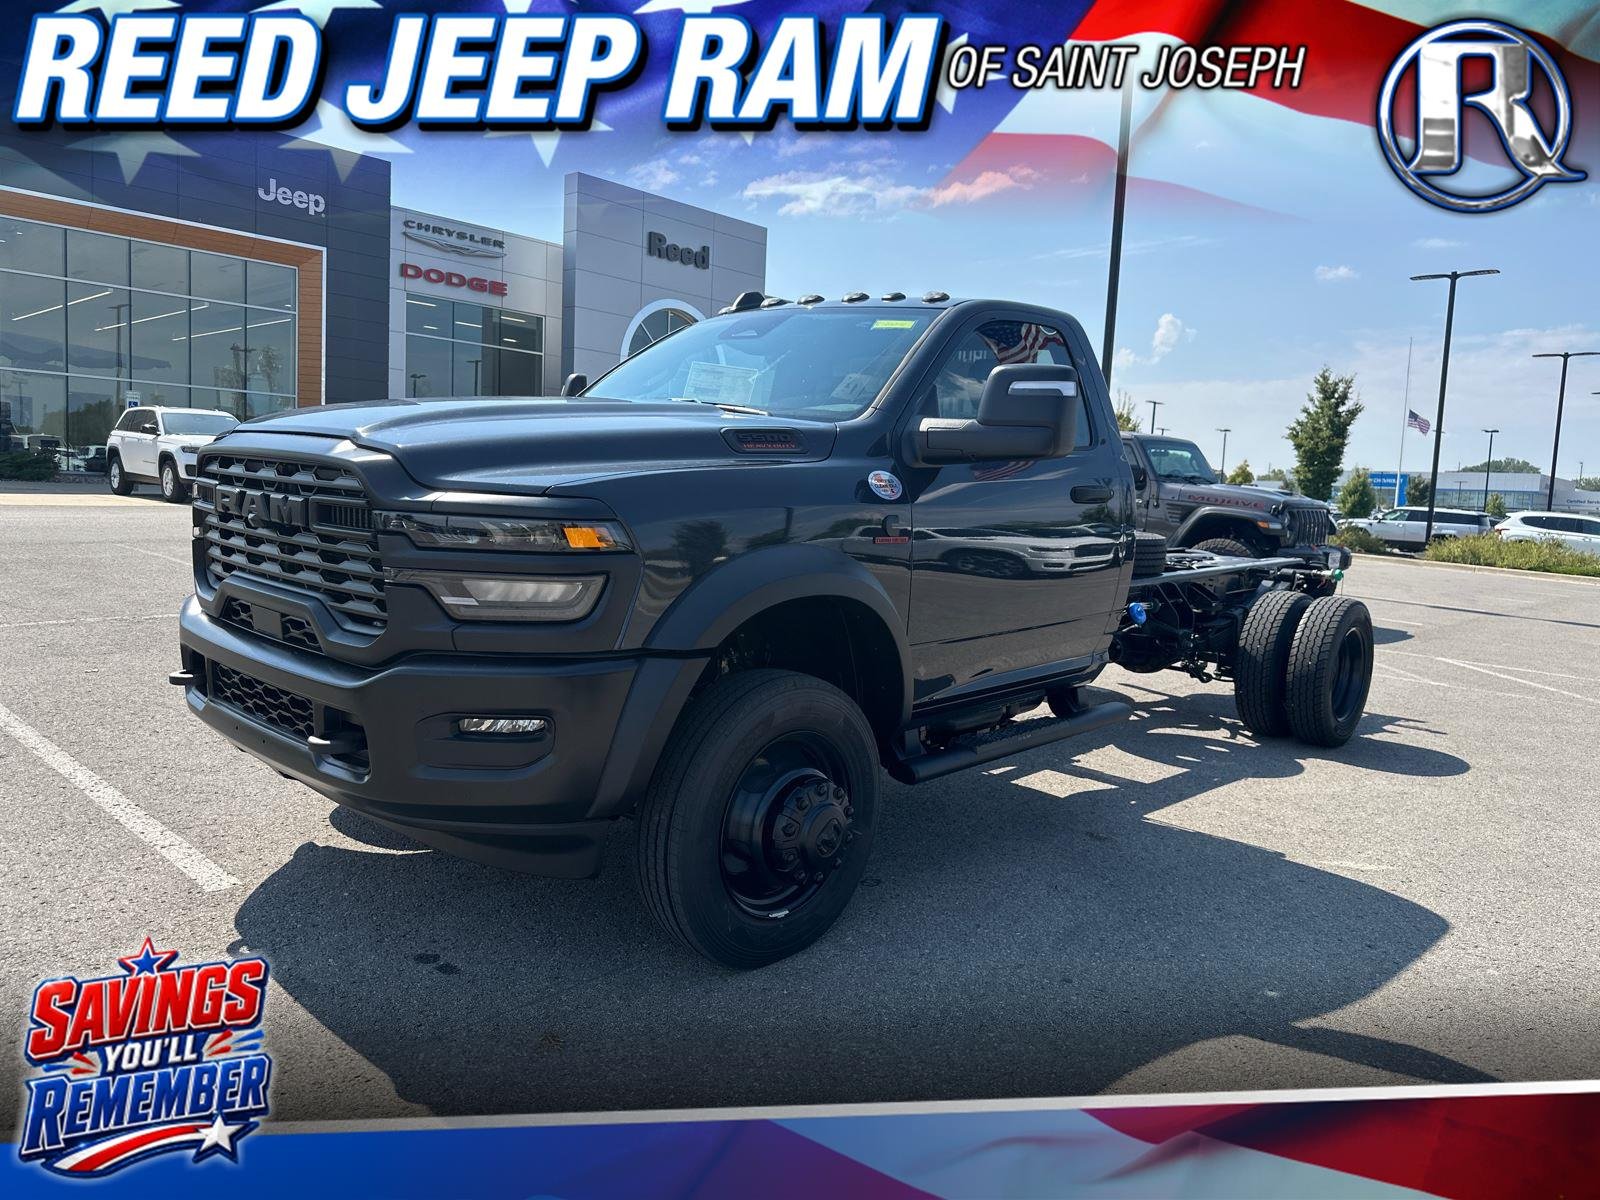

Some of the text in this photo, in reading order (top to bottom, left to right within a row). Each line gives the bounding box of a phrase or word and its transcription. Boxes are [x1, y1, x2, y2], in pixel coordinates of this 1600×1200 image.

[258, 178, 326, 217] Jeep
[403, 220, 505, 249] CHRYSLER
[647, 231, 710, 270] Reed
[399, 263, 508, 297] DODGE
[216, 485, 307, 526] RAM
